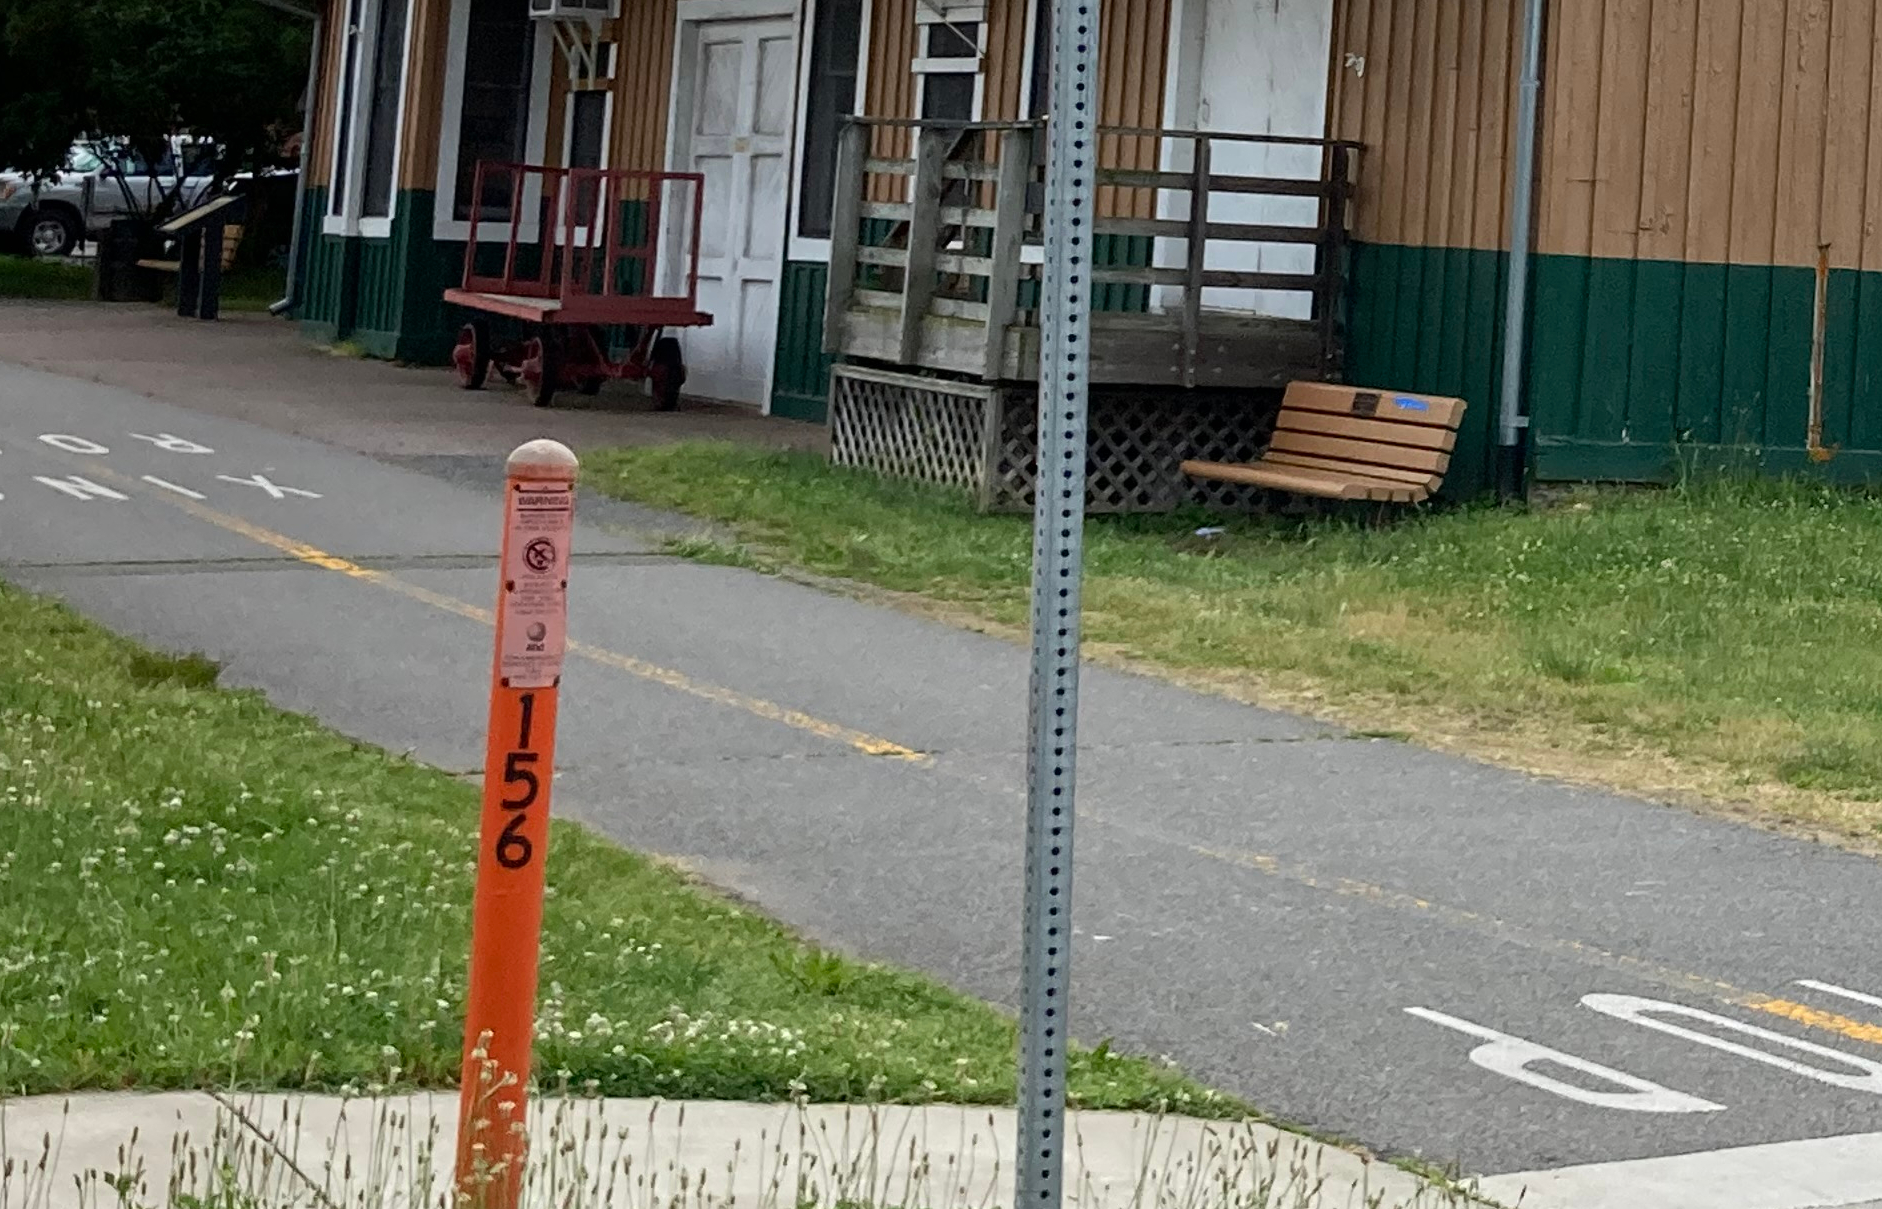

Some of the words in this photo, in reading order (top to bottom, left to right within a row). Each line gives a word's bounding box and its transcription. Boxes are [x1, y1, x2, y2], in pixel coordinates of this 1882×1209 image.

[0, 433, 215, 454] RO
[0, 475, 324, 500] XIN
[496, 693, 539, 869] 156
